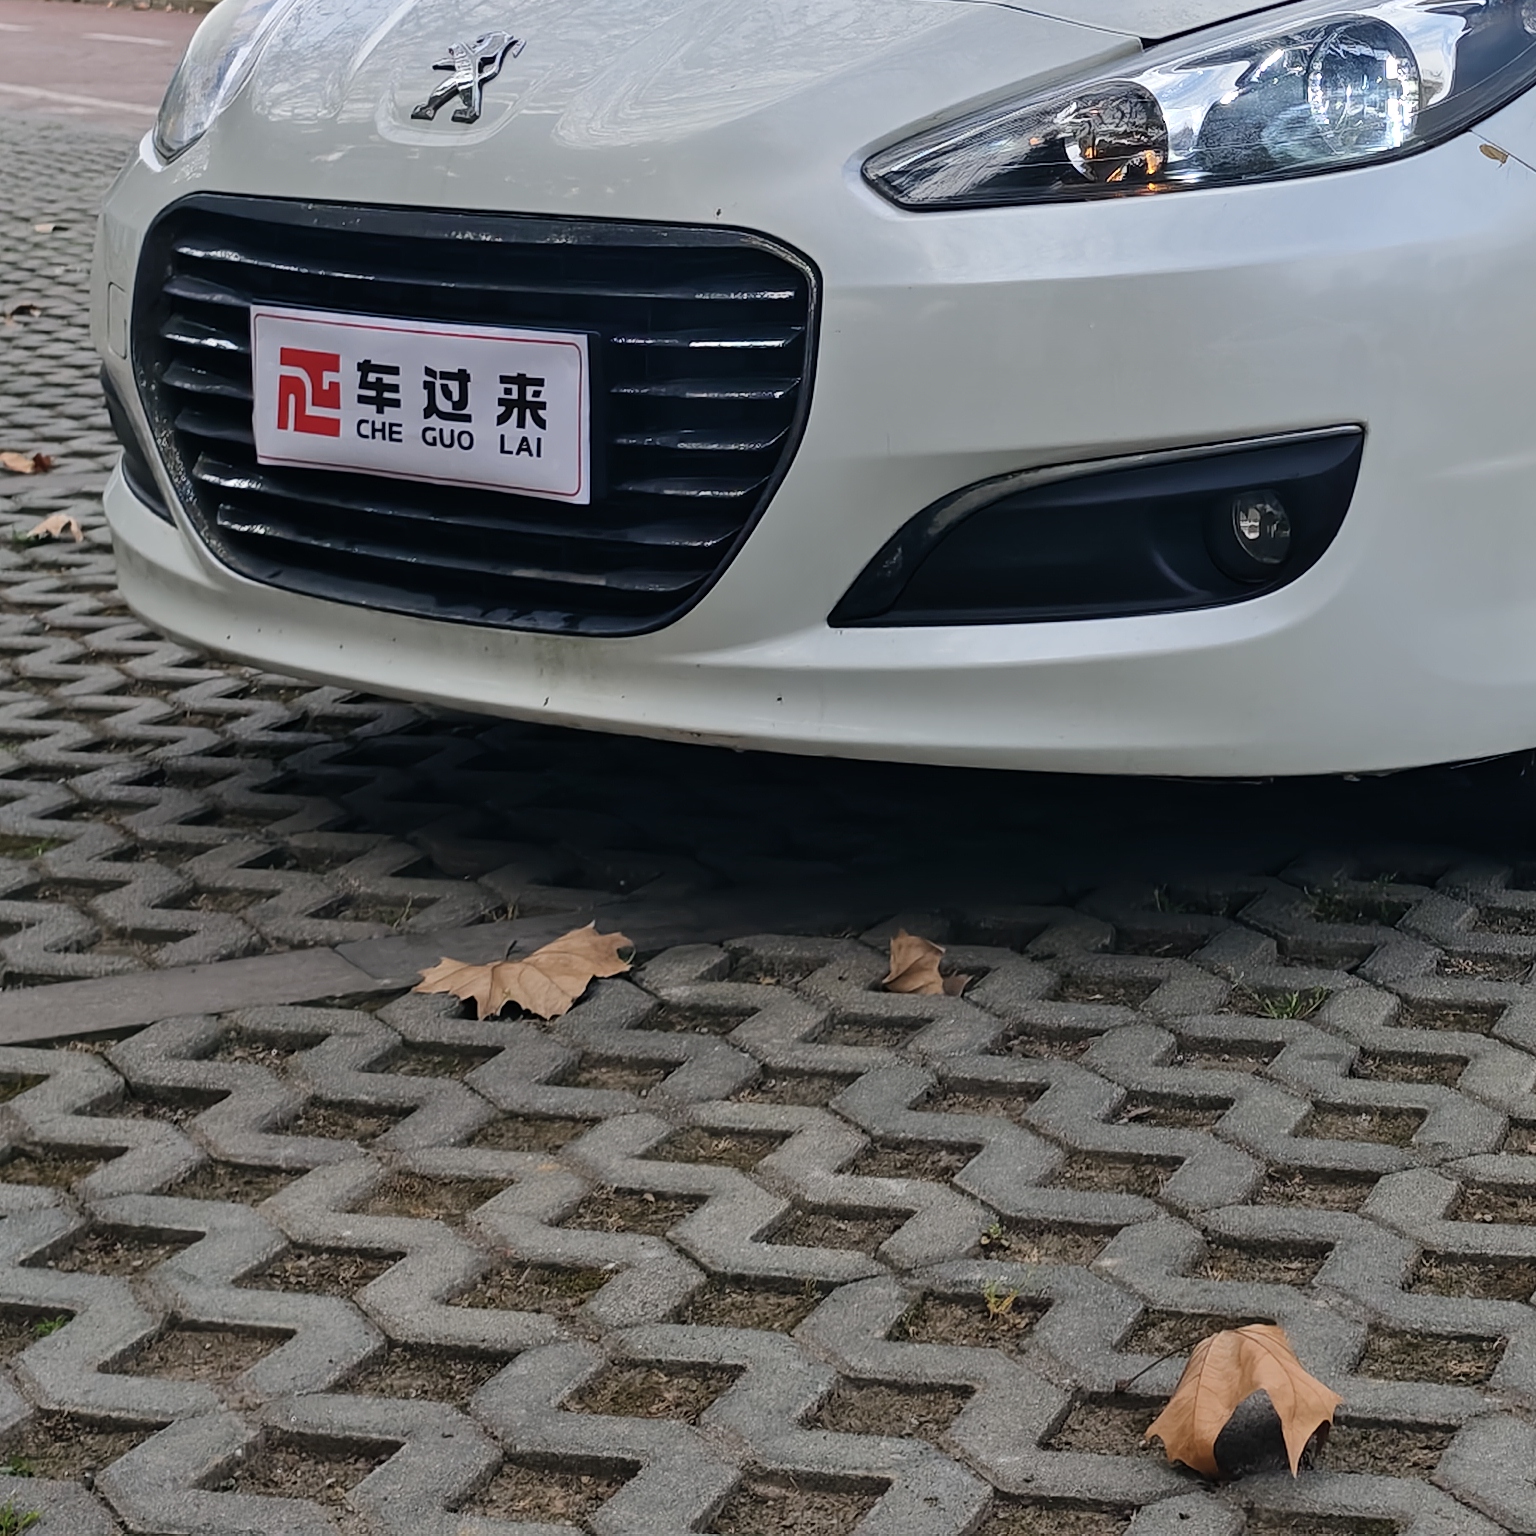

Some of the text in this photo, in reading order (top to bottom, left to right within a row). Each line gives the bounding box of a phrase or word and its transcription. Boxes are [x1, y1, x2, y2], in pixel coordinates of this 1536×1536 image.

[356, 359, 547, 431] 车过来
[356, 418, 542, 459] CHE GUO LAI
